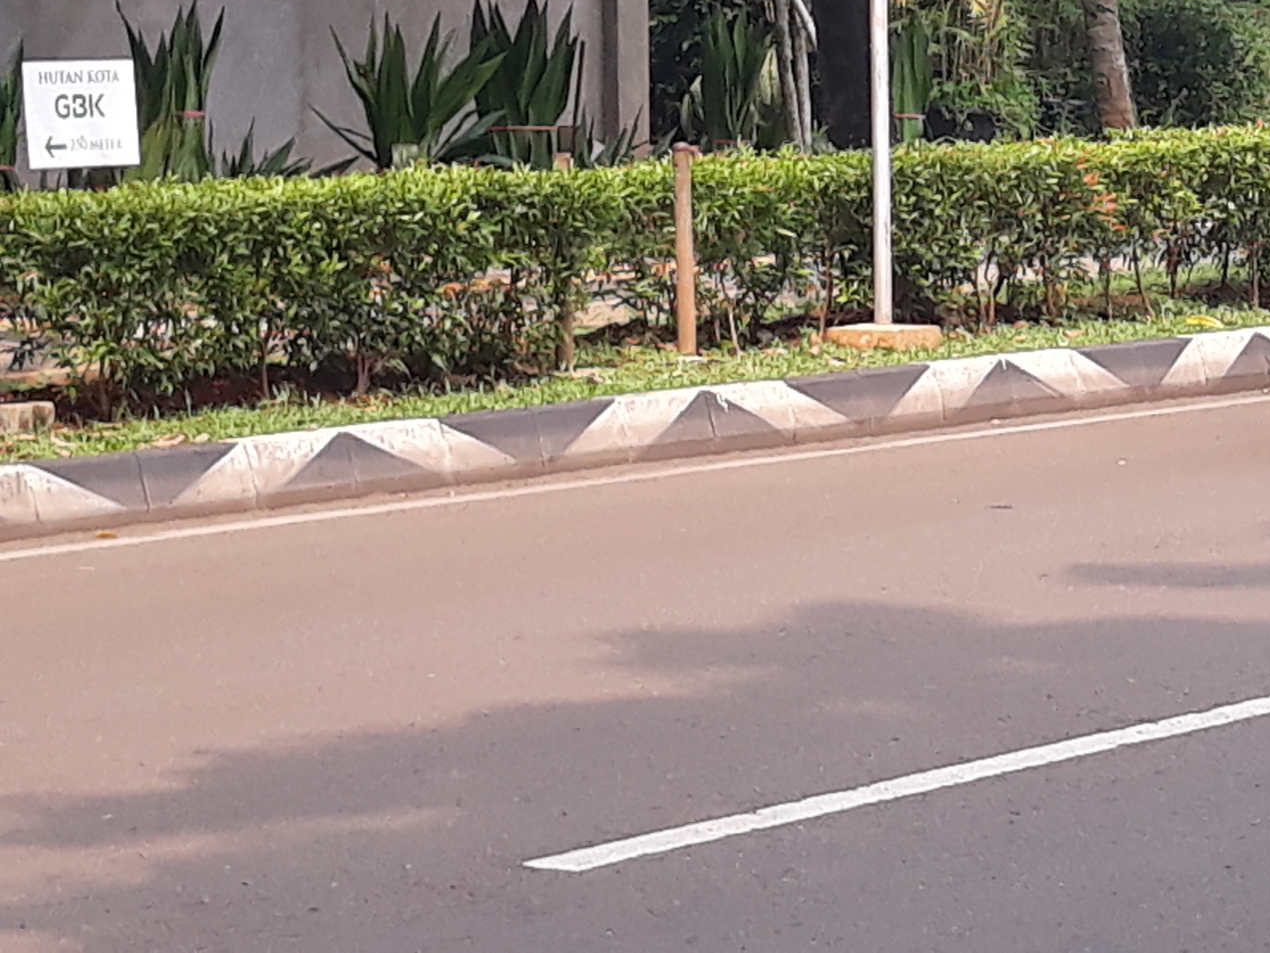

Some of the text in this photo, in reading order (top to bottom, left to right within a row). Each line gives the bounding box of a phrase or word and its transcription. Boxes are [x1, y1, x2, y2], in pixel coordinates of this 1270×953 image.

[38, 69, 120, 85] HUTAN KOTA
[54, 93, 106, 119] GBK
